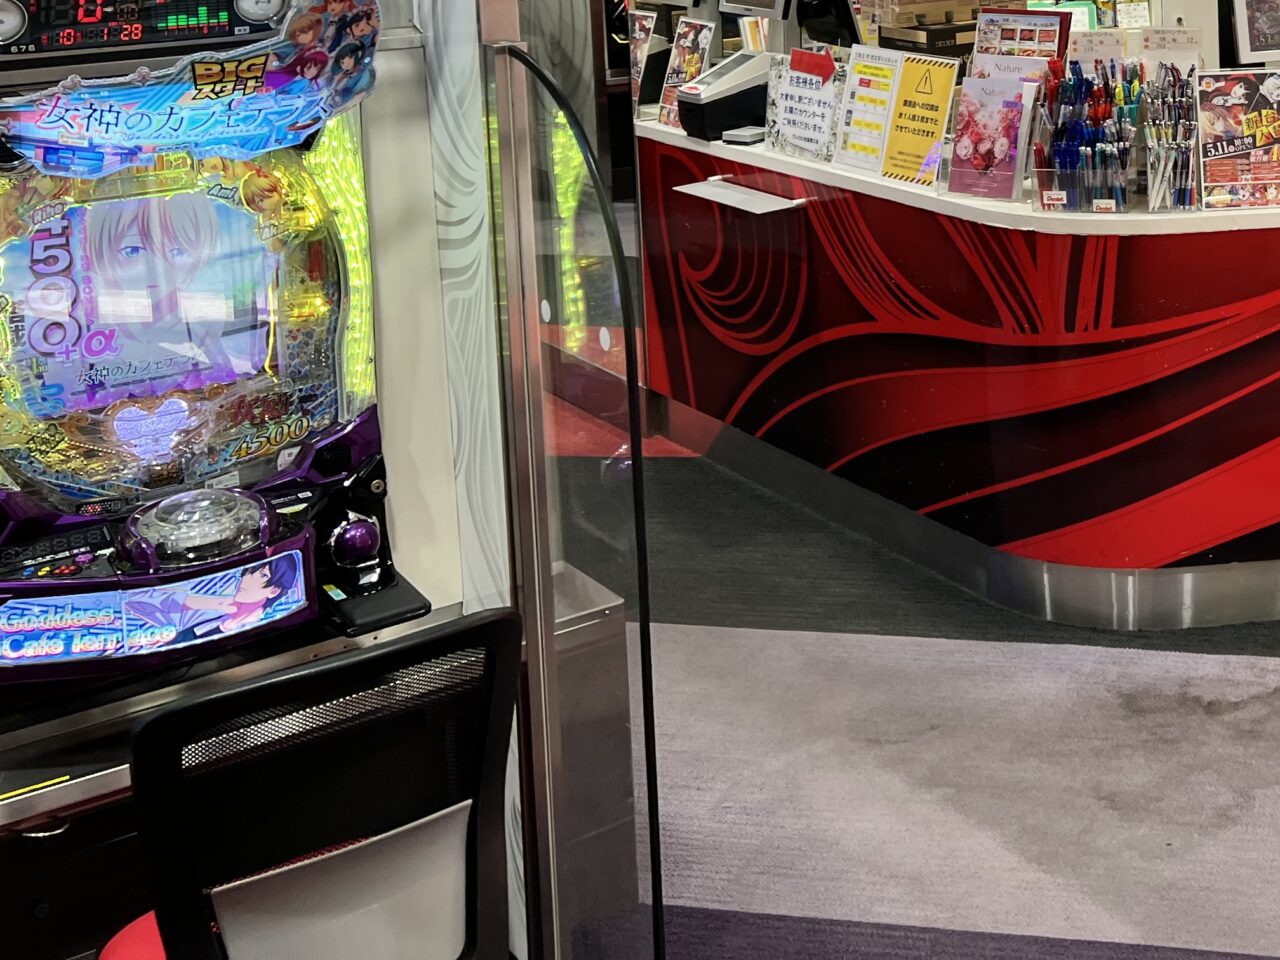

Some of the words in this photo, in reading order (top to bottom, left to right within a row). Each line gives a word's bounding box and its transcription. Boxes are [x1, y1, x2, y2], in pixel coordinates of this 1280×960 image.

[194, 54, 268, 84] BIG
[994, 63, 1023, 74] Nature
[192, 79, 263, 101] スタート
[38, 94, 334, 136] 女神のカフェテラス
[231, 416, 310, 459] 4500
[0, 604, 115, 634] Goddess
